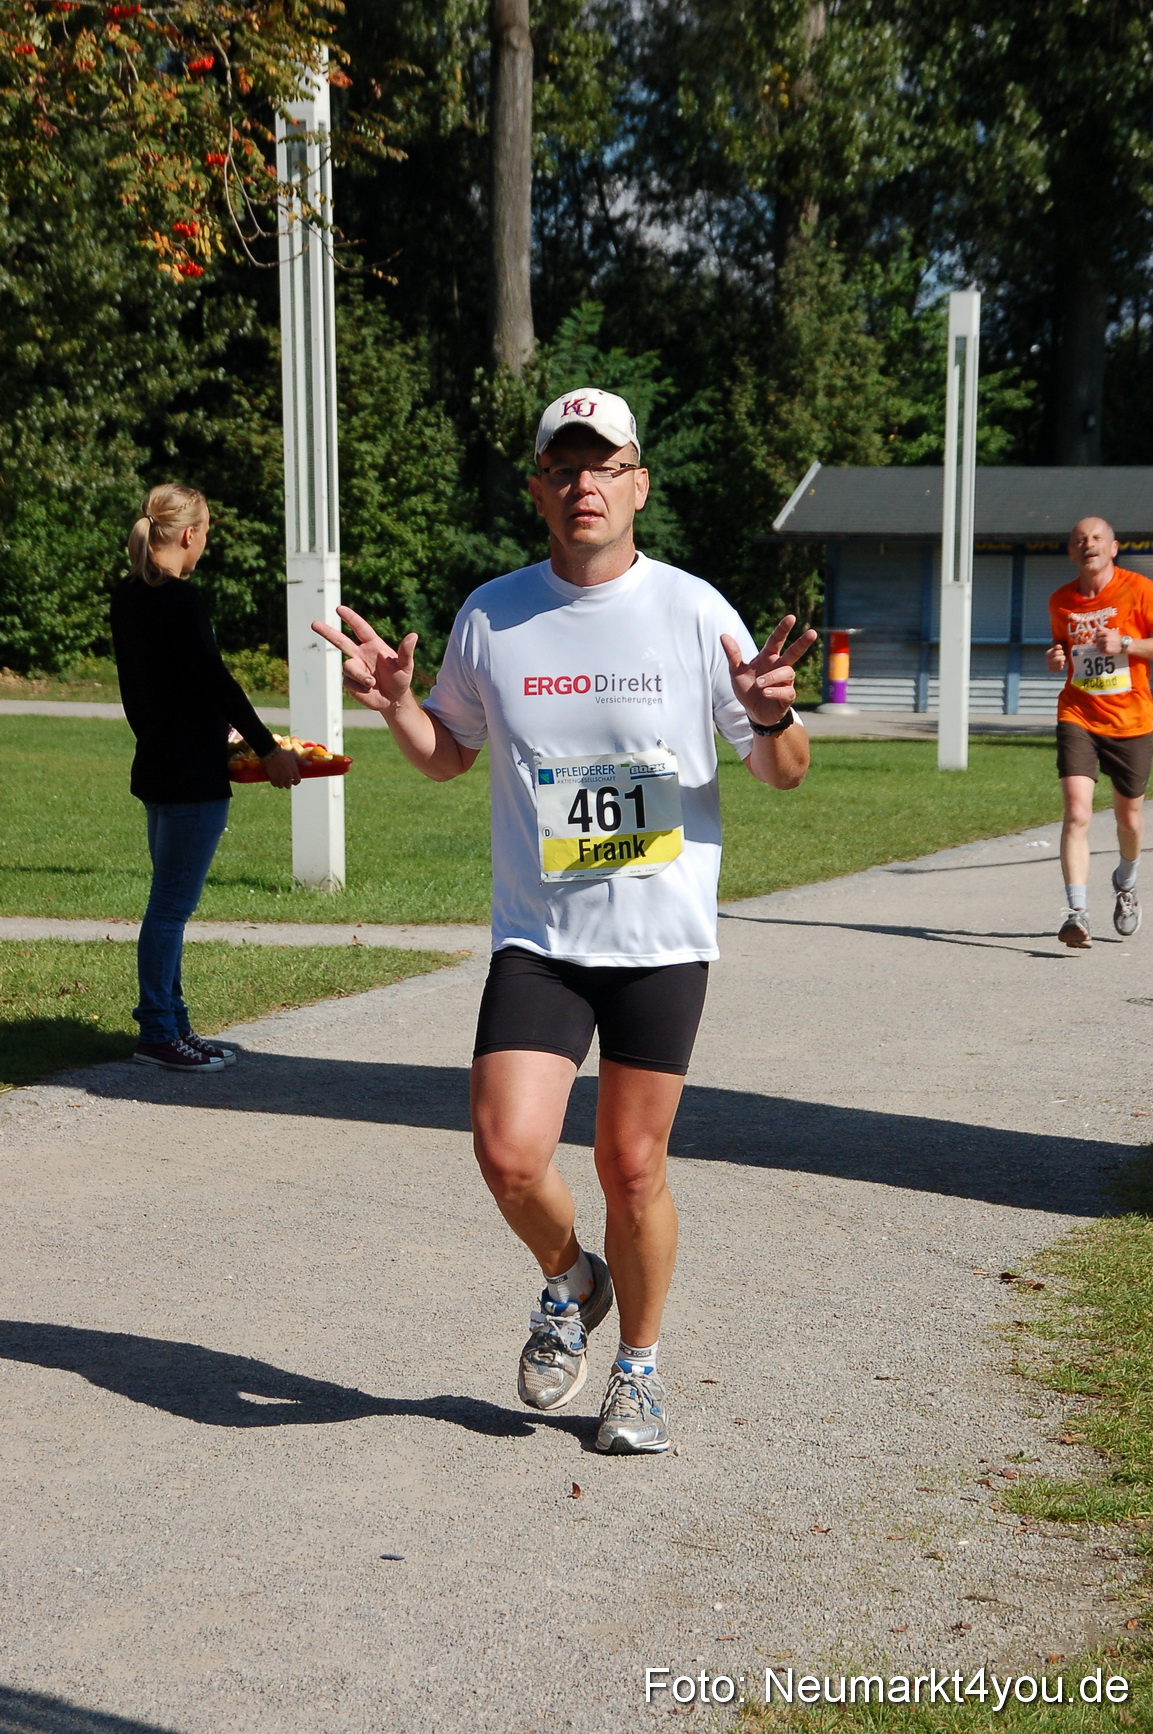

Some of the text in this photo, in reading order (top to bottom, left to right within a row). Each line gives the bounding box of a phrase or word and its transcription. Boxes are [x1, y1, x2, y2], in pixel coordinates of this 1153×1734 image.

[1083, 656, 1116, 677] 365
[523, 673, 663, 696] ERGO Direkt
[1083, 676, 1118, 689] Roland
[594, 696, 663, 706] Versicherungen
[555, 764, 616, 778] PFLEIDERER
[556, 775, 616, 785] AKTIENGESELLSCHAFT
[567, 784, 647, 833] 461
[578, 834, 647, 863] Frank
